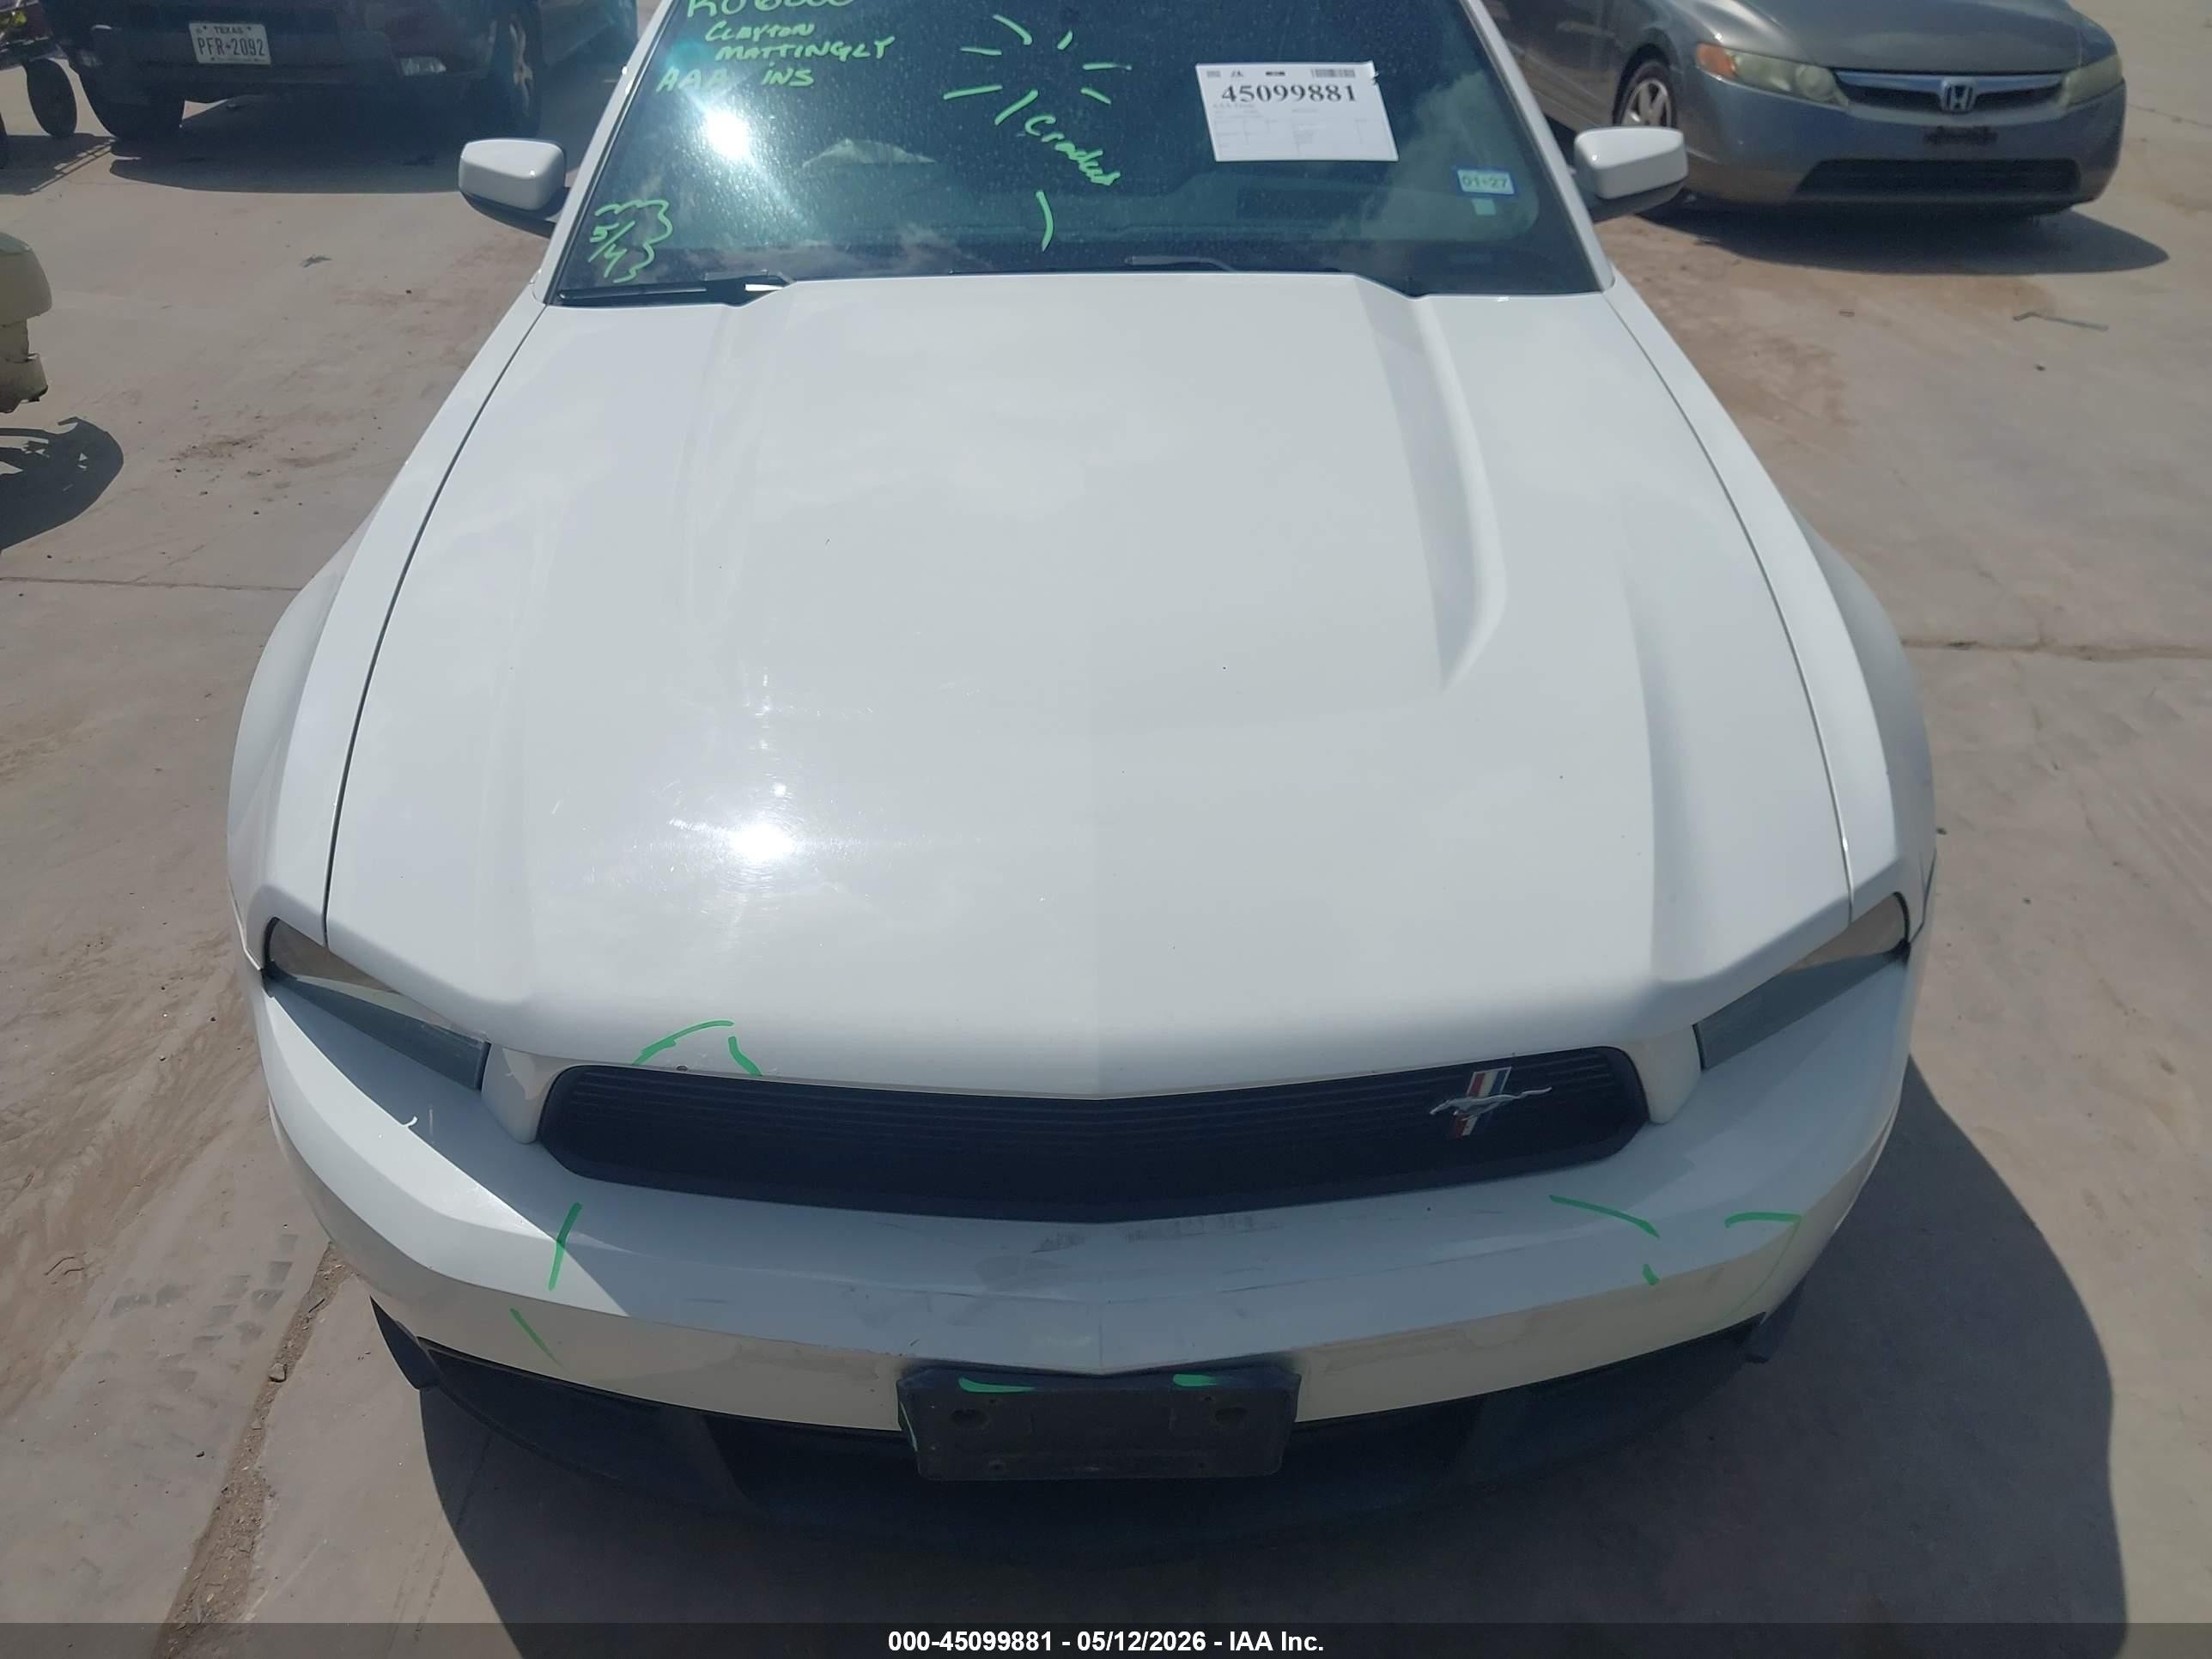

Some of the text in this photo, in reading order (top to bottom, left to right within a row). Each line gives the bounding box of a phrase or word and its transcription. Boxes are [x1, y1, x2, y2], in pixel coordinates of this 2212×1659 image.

[214, 26, 244, 34] TEXAS
[714, 36, 896, 62] MATTINGLY
[1221, 84, 1357, 103] 45099881
